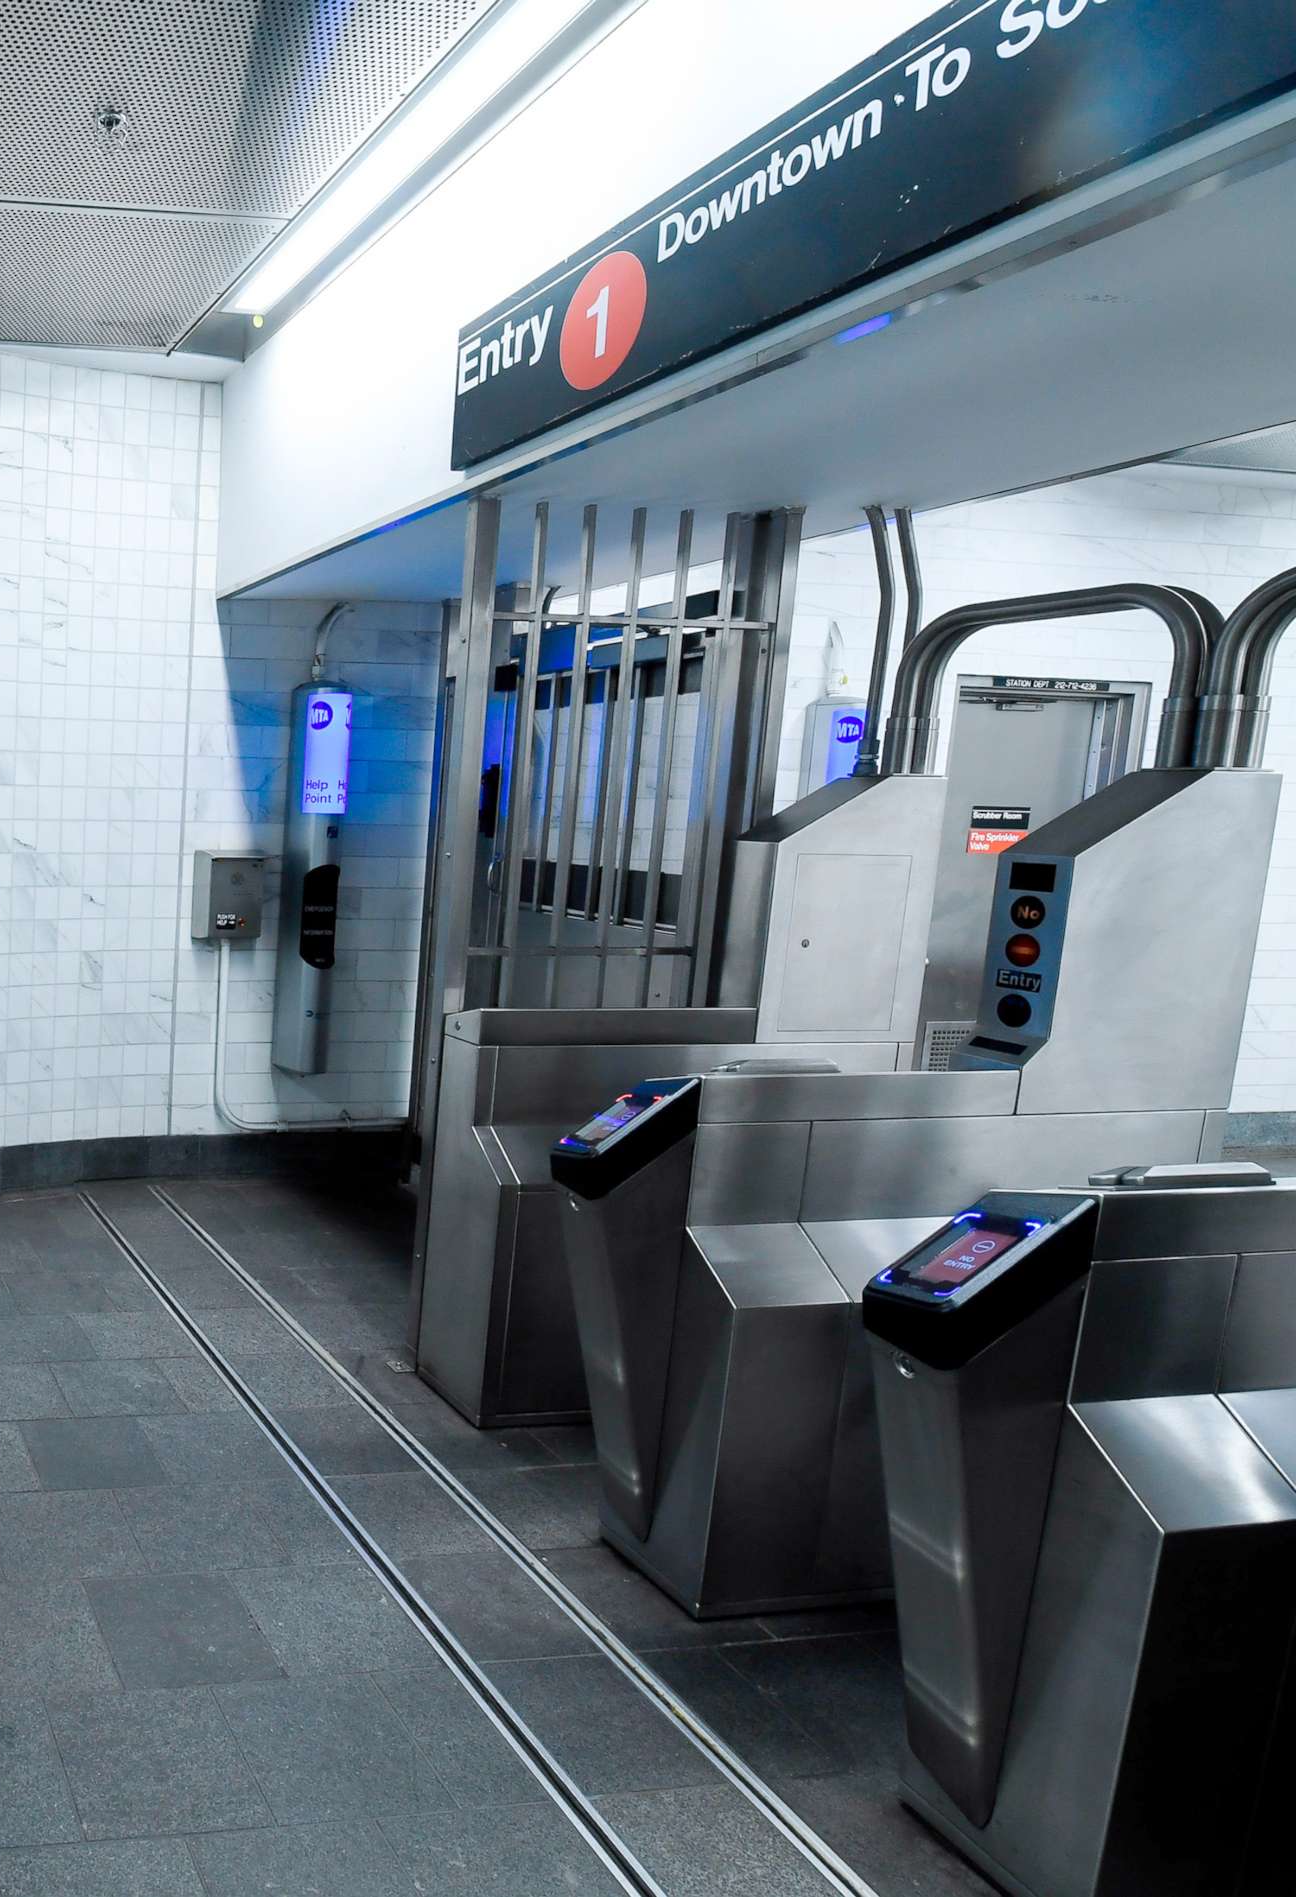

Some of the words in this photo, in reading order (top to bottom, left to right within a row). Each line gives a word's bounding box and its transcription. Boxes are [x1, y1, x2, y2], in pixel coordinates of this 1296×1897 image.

[457, 304, 554, 396] Entry
[586, 285, 610, 359] 1
[657, 98, 883, 264] Downtown
[905, 43, 971, 112] To
[996, 0, 1106, 58] So
[1006, 679, 1031, 688] STATION
[1033, 680, 1049, 689] DEPT
[305, 780, 328, 791] Help
[304, 794, 331, 804] Point
[970, 832, 985, 841] Fire
[969, 841, 990, 851] Valve
[1017, 905, 1040, 920] No
[998, 970, 1041, 992] Entry
[959, 1255, 976, 1263] NO
[943, 1260, 977, 1270] ENTRY
